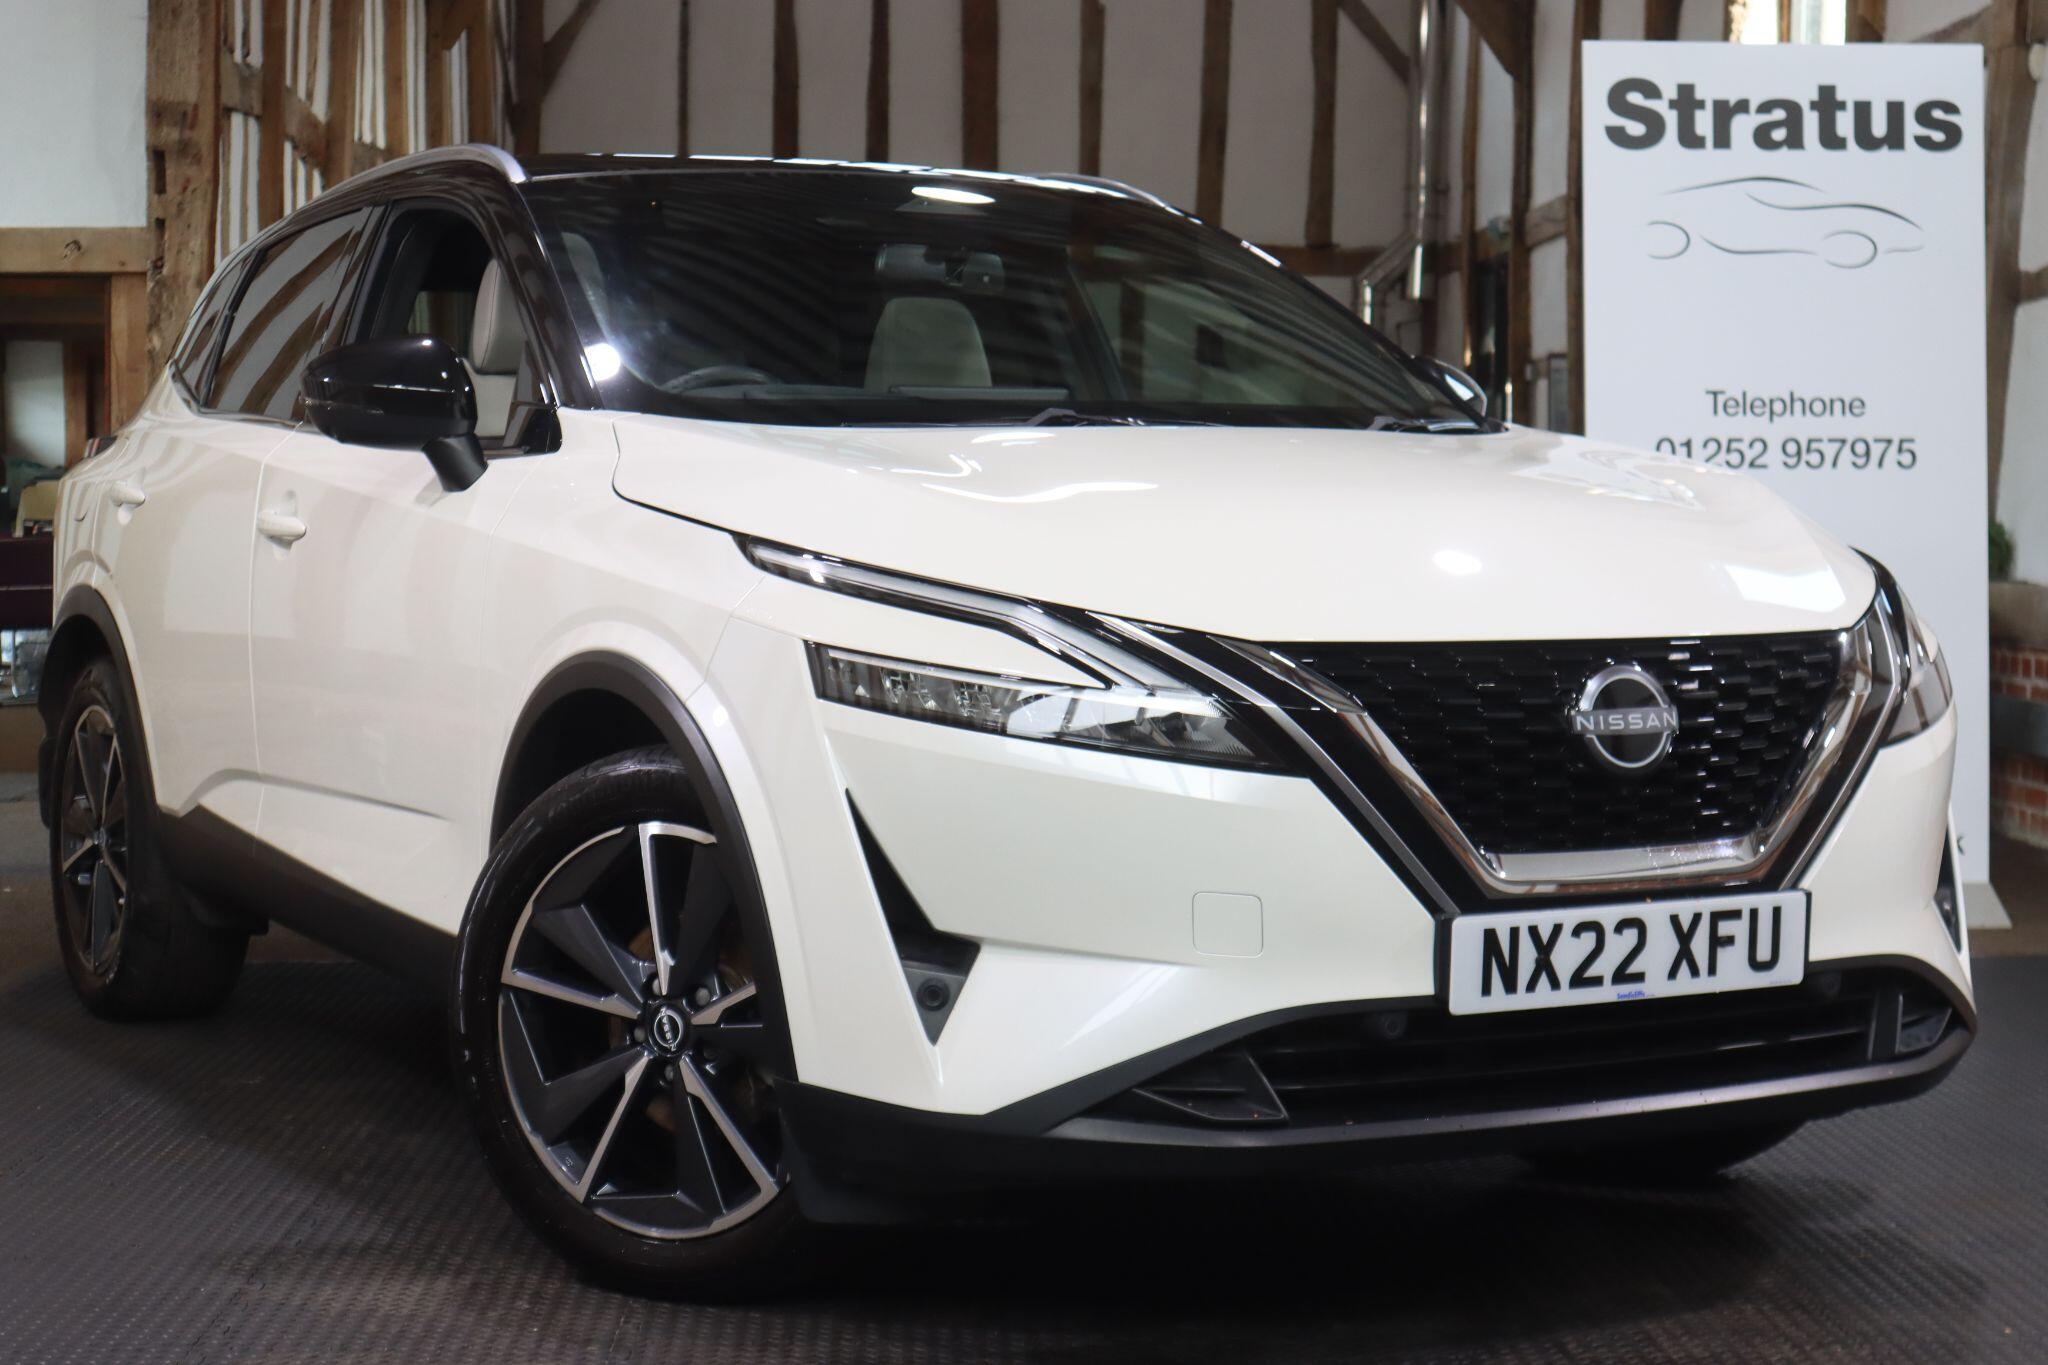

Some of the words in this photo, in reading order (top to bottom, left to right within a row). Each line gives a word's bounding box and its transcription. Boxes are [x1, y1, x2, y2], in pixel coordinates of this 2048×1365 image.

[1605, 78, 1963, 152] Stratus
[1706, 391, 1866, 423] Telephone
[1781, 437, 1917, 469] 957975
[1576, 711, 1677, 730] NISSAN
[1481, 917, 1648, 997] NX22
[1667, 906, 1782, 981] XFU
